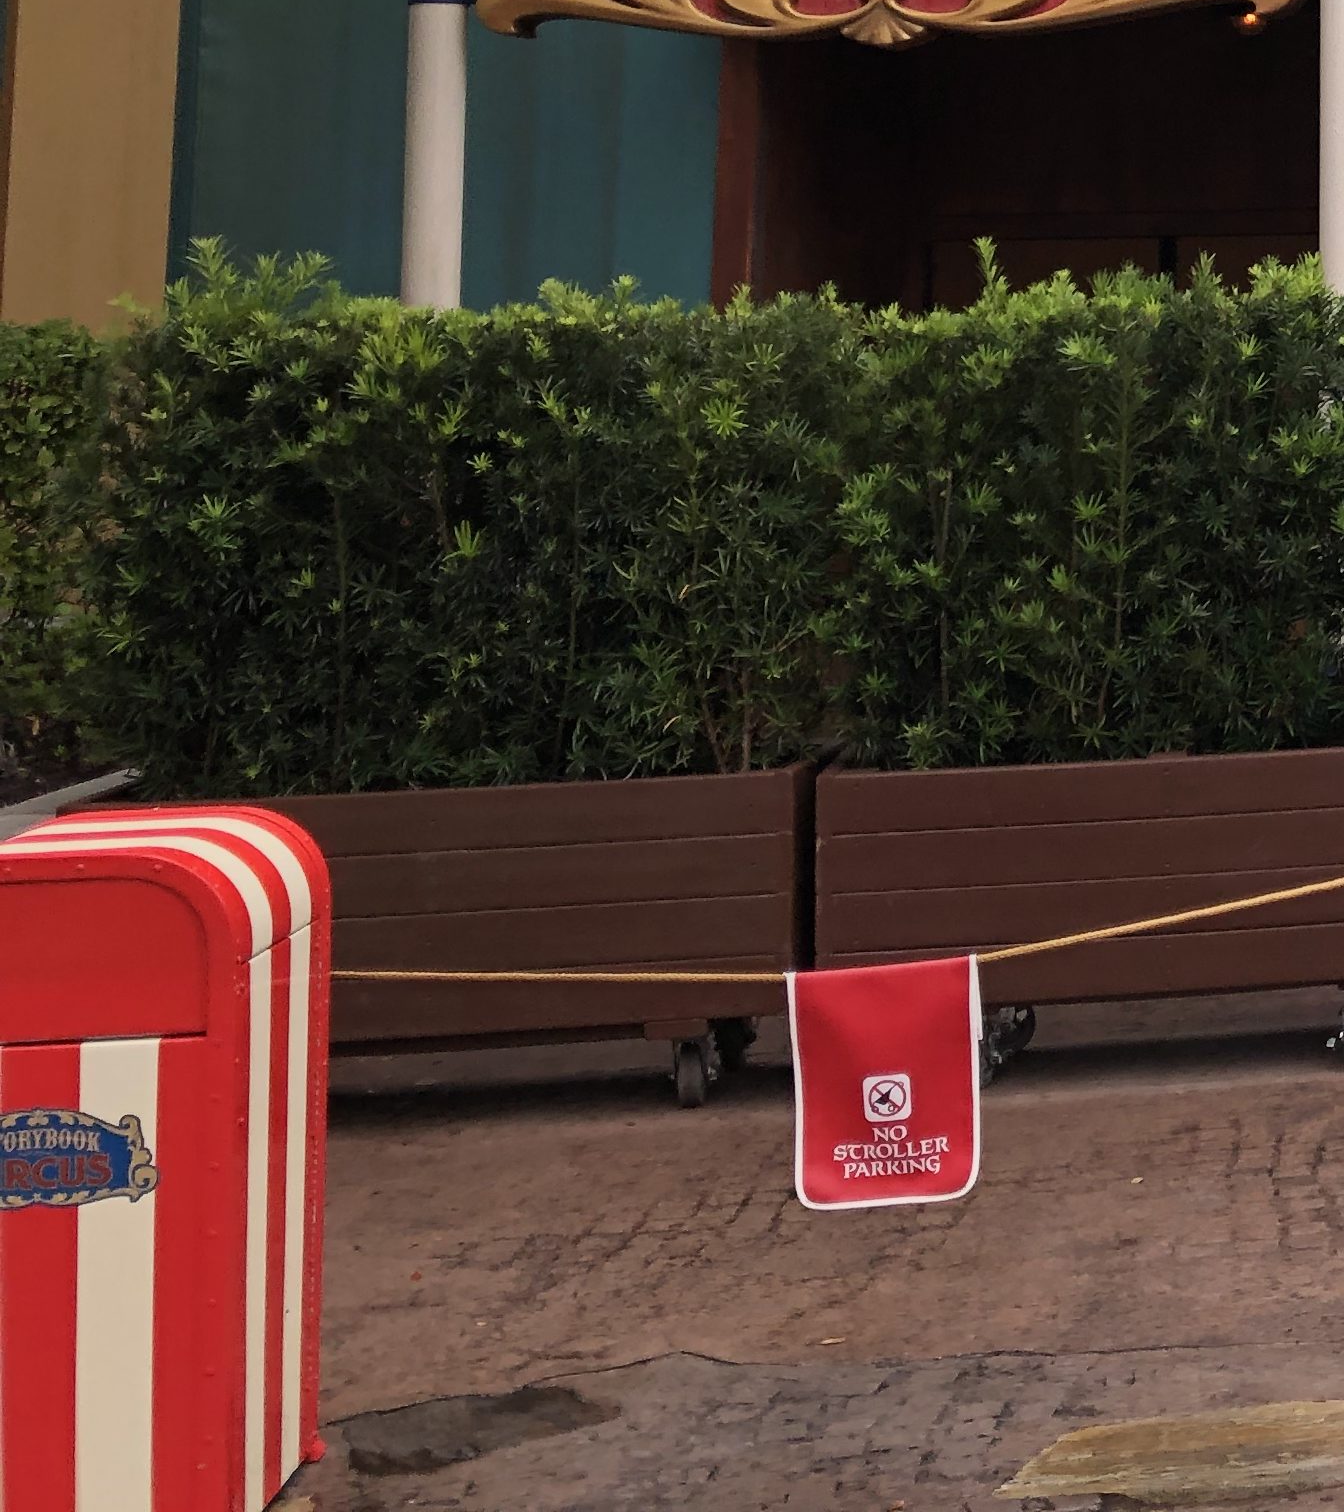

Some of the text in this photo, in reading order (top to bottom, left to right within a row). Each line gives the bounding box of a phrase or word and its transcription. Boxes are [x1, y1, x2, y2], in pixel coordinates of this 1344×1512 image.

[0, 1128, 100, 1153] ORYBOOK
[872, 1125, 907, 1142] NO
[833, 1137, 950, 1162] STROLLER
[844, 1155, 940, 1179] PARKING
